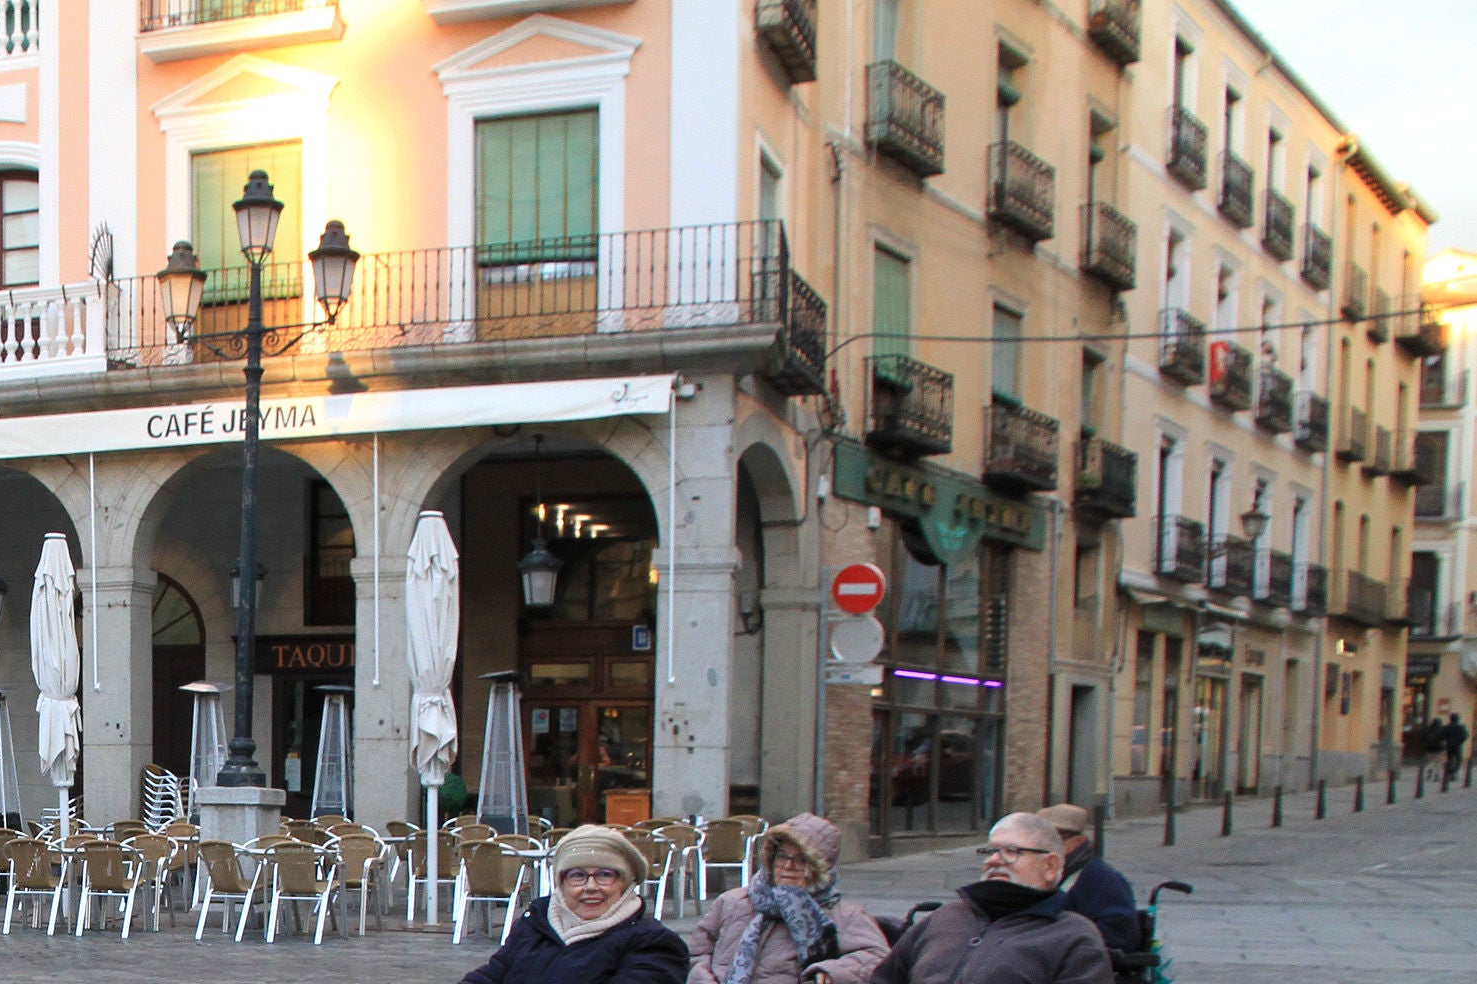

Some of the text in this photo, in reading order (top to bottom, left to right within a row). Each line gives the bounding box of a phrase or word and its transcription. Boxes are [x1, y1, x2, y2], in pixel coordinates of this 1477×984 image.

[147, 404, 317, 439] CAFÉ JEYMA
[272, 643, 356, 668] TAQUI
